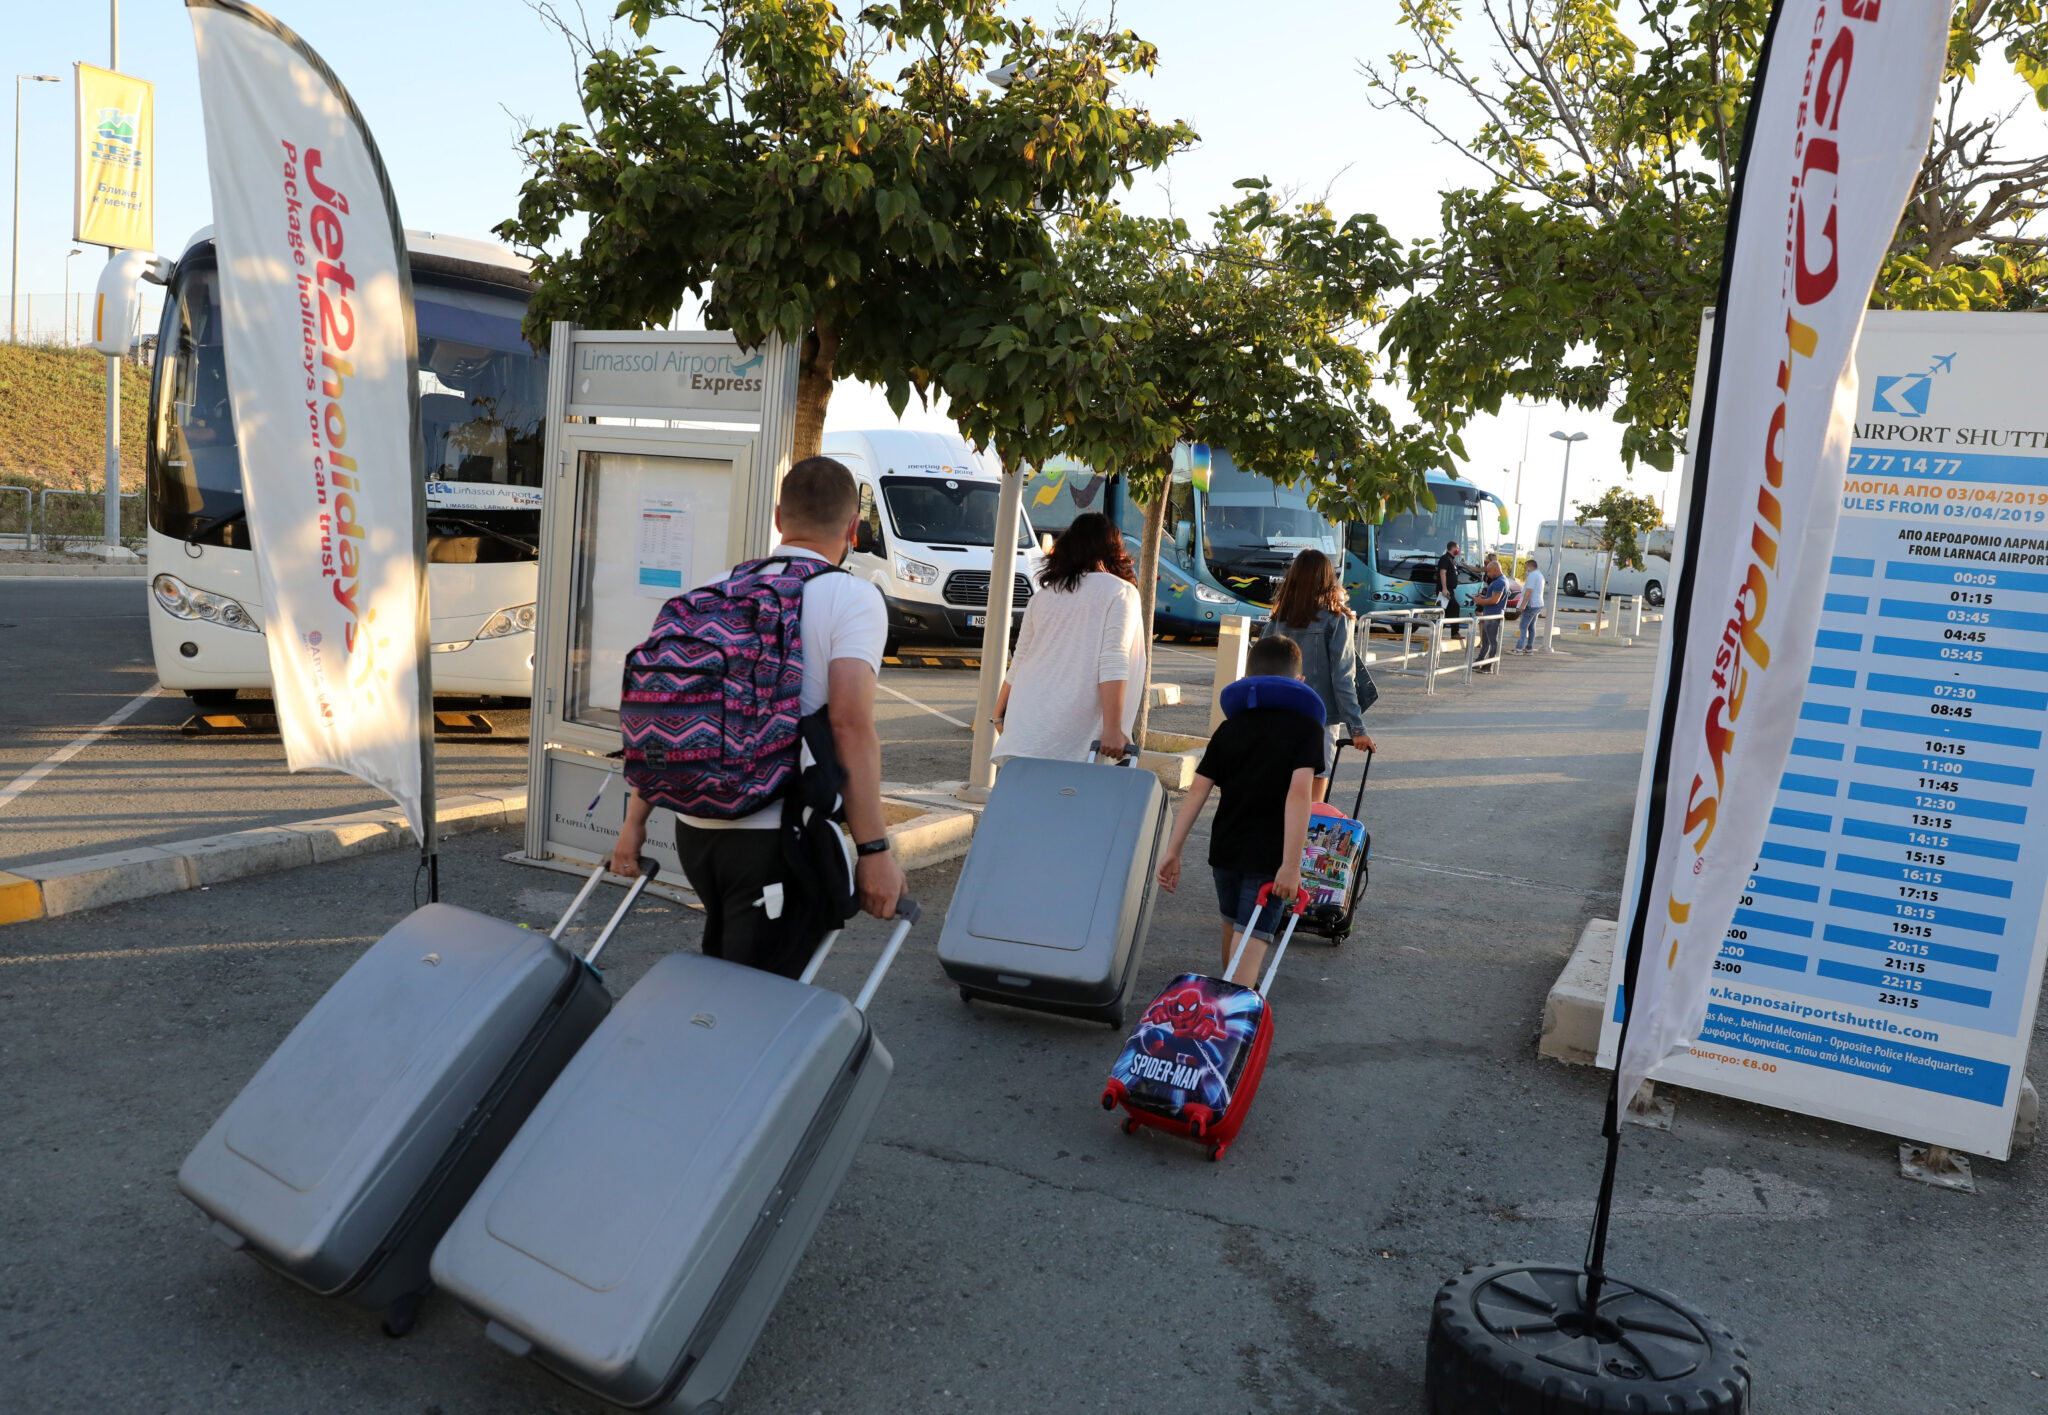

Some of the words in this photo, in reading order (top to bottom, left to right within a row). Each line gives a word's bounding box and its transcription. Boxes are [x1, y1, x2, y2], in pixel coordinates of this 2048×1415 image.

[281, 139, 307, 267] Package
[296, 272, 317, 392] holidays
[582, 350, 659, 373] Limassol
[662, 351, 734, 377] Airport
[691, 373, 762, 396] Express
[303, 147, 366, 655] Jet2holidays
[305, 398, 322, 448] you
[1955, 427, 2048, 449] SHUTT
[908, 464, 941, 472] meeting
[1867, 455, 1895, 471] 77
[1902, 456, 1928, 473] 14
[1933, 459, 1962, 475] 77
[314, 455, 327, 505] can
[453, 486, 495, 496] Limassol
[497, 487, 533, 499] Airport
[1946, 487, 2048, 506] 03/04/2019
[513, 497, 542, 505] Expre
[1889, 501, 1939, 516] FROM
[1943, 504, 2045, 524] 03/04/2019
[319, 512, 337, 579] trust
[1924, 531, 2002, 548] ΑΕΡΟΔΡΟΜΙΟ
[1908, 545, 1941, 558] FROM
[1943, 548, 1996, 562] LARNACA
[1953, 572, 1997, 586] 00:05
[1950, 591, 1993, 605] 01:15
[1947, 610, 1990, 624] 03:45
[1944, 629, 1986, 643] 04:45
[1940, 647, 1983, 662] 05:45
[1934, 685, 1976, 699] 07:30
[1930, 704, 1972, 718] 08:45
[1925, 741, 1966, 755] 10:15
[1922, 759, 1963, 774] 11:00
[1919, 778, 1959, 792] 11:45
[1915, 796, 1956, 811] 12:30
[1912, 814, 1952, 829] 13:15
[1909, 832, 1949, 847] 14:15
[1906, 850, 1945, 865] 15:15
[1902, 868, 1942, 884] 16:15
[1899, 886, 1938, 902] 17:15
[1896, 904, 1936, 920] 18:15
[1893, 922, 1932, 938] 19:15
[1720, 944, 1745, 957] 2:00
[1888, 939, 1929, 956] 20:15
[1713, 960, 1742, 974] 3:00
[1884, 957, 1926, 974] 21:15
[1881, 975, 1923, 992] 22:15
[1878, 992, 1919, 1009] 23:15
[1709, 987, 1939, 1042] w.kapnosairportshuttle.com
[1740, 1017, 1773, 1033] behind
[1774, 1024, 1823, 1044] Melconian
[1830, 1036, 1873, 1055] Opposite
[1874, 1045, 1902, 1061] Police
[1904, 1052, 1974, 1076] Headquarters
[1689, 1045, 1740, 1065] όμιστρο:
[1742, 1058, 1778, 1074] €8.00
[1130, 1053, 1201, 1091] SPIDER-MAN
